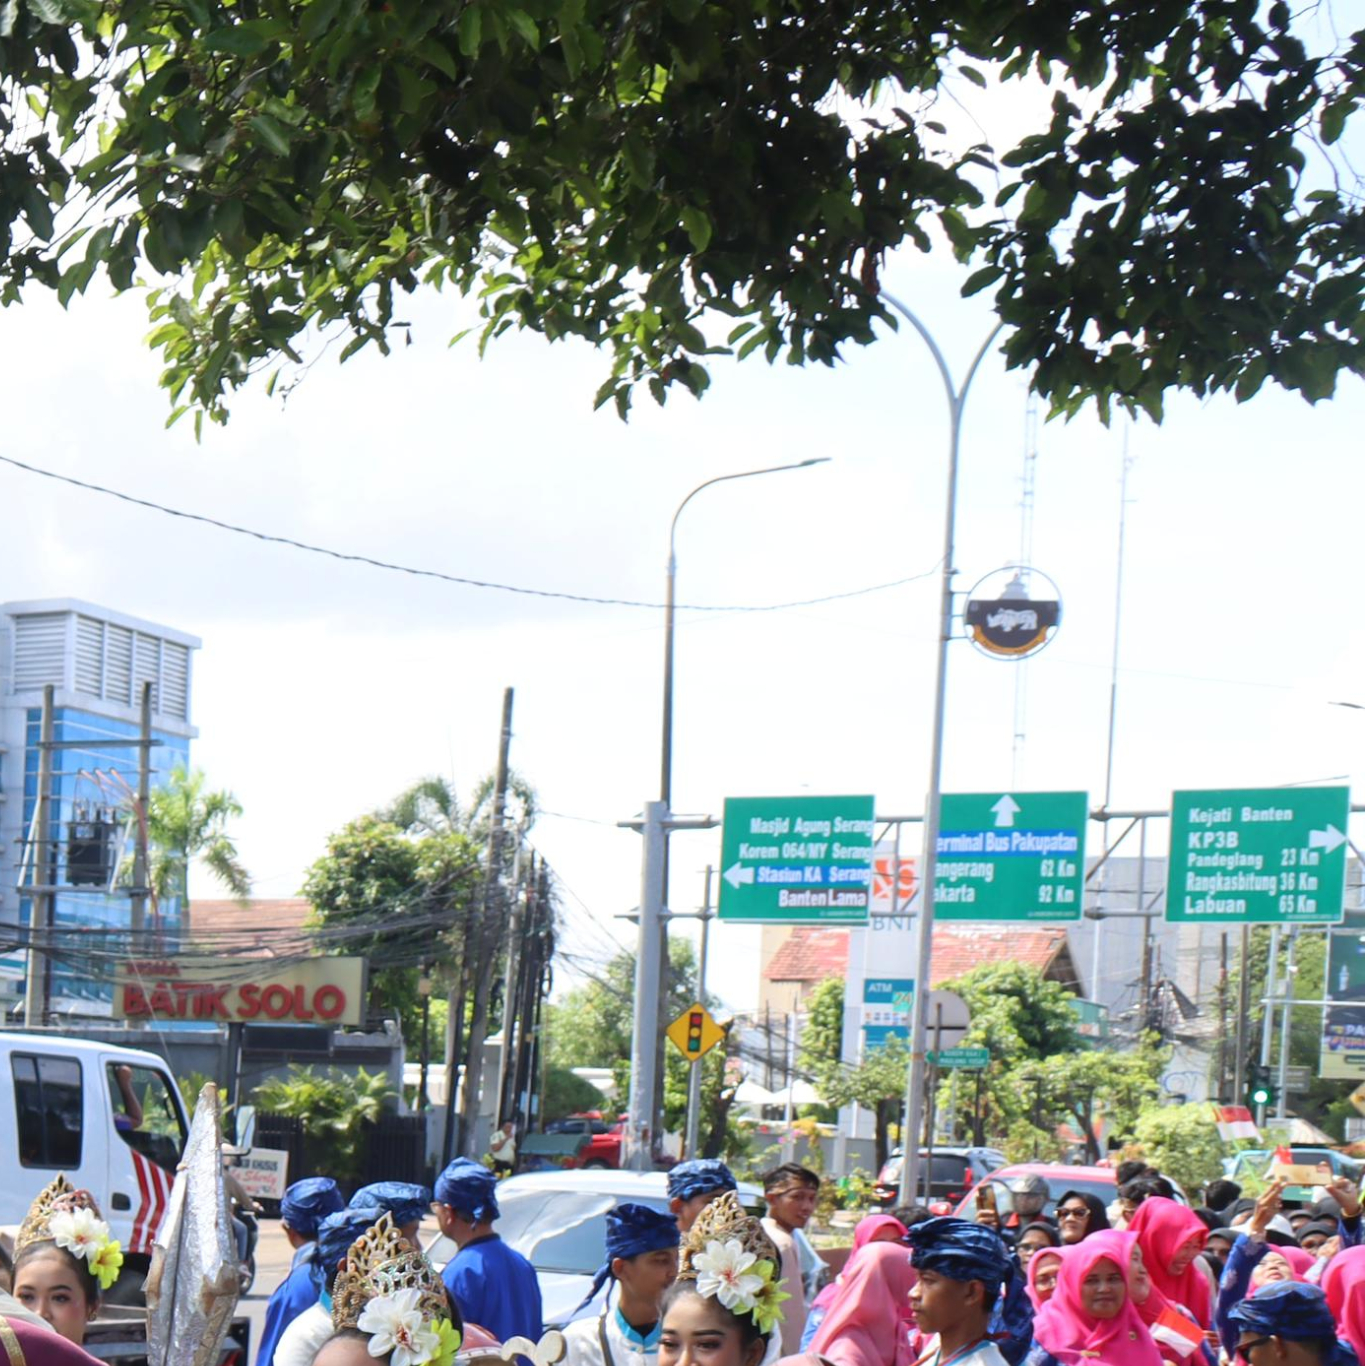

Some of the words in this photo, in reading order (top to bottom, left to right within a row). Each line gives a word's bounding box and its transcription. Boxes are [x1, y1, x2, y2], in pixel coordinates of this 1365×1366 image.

[750, 817, 790, 837] Masjid
[794, 816, 831, 837] Agung
[833, 816, 874, 837] Serang
[1188, 807, 1232, 827] Kejati
[1240, 806, 1294, 822] Banten
[937, 833, 984, 852] erminal
[985, 831, 1009, 852] Bus
[1012, 831, 1078, 855] Pakupatan
[1187, 831, 1239, 849] KP3B
[739, 843, 779, 859] Korem
[832, 842, 872, 864] Serang
[1187, 852, 1264, 870] Pandeglang
[1281, 848, 1296, 866] 23
[1300, 848, 1319, 866] Km
[757, 866, 802, 883] Stasiun
[804, 866, 822, 882] KA
[829, 865, 870, 884] Serang
[935, 861, 994, 882] angerang
[1040, 859, 1054, 877] 62
[1057, 859, 1076, 877] Km
[934, 884, 975, 902] akarta
[1038, 885, 1052, 903] 92
[1055, 885, 1074, 902] Km
[1185, 871, 1278, 896] Rangkasbitung
[1280, 872, 1295, 891] 36
[1298, 872, 1318, 891] Km
[778, 888, 826, 907] Banten
[828, 889, 867, 907] Lama
[1184, 895, 1246, 914] Labuan
[1278, 894, 1295, 914] 65
[1297, 894, 1317, 914] Km
[872, 916, 915, 931] BNI
[869, 983, 892, 993] ATM
[123, 981, 233, 1019] BATIK
[236, 982, 346, 1020] SOLO
